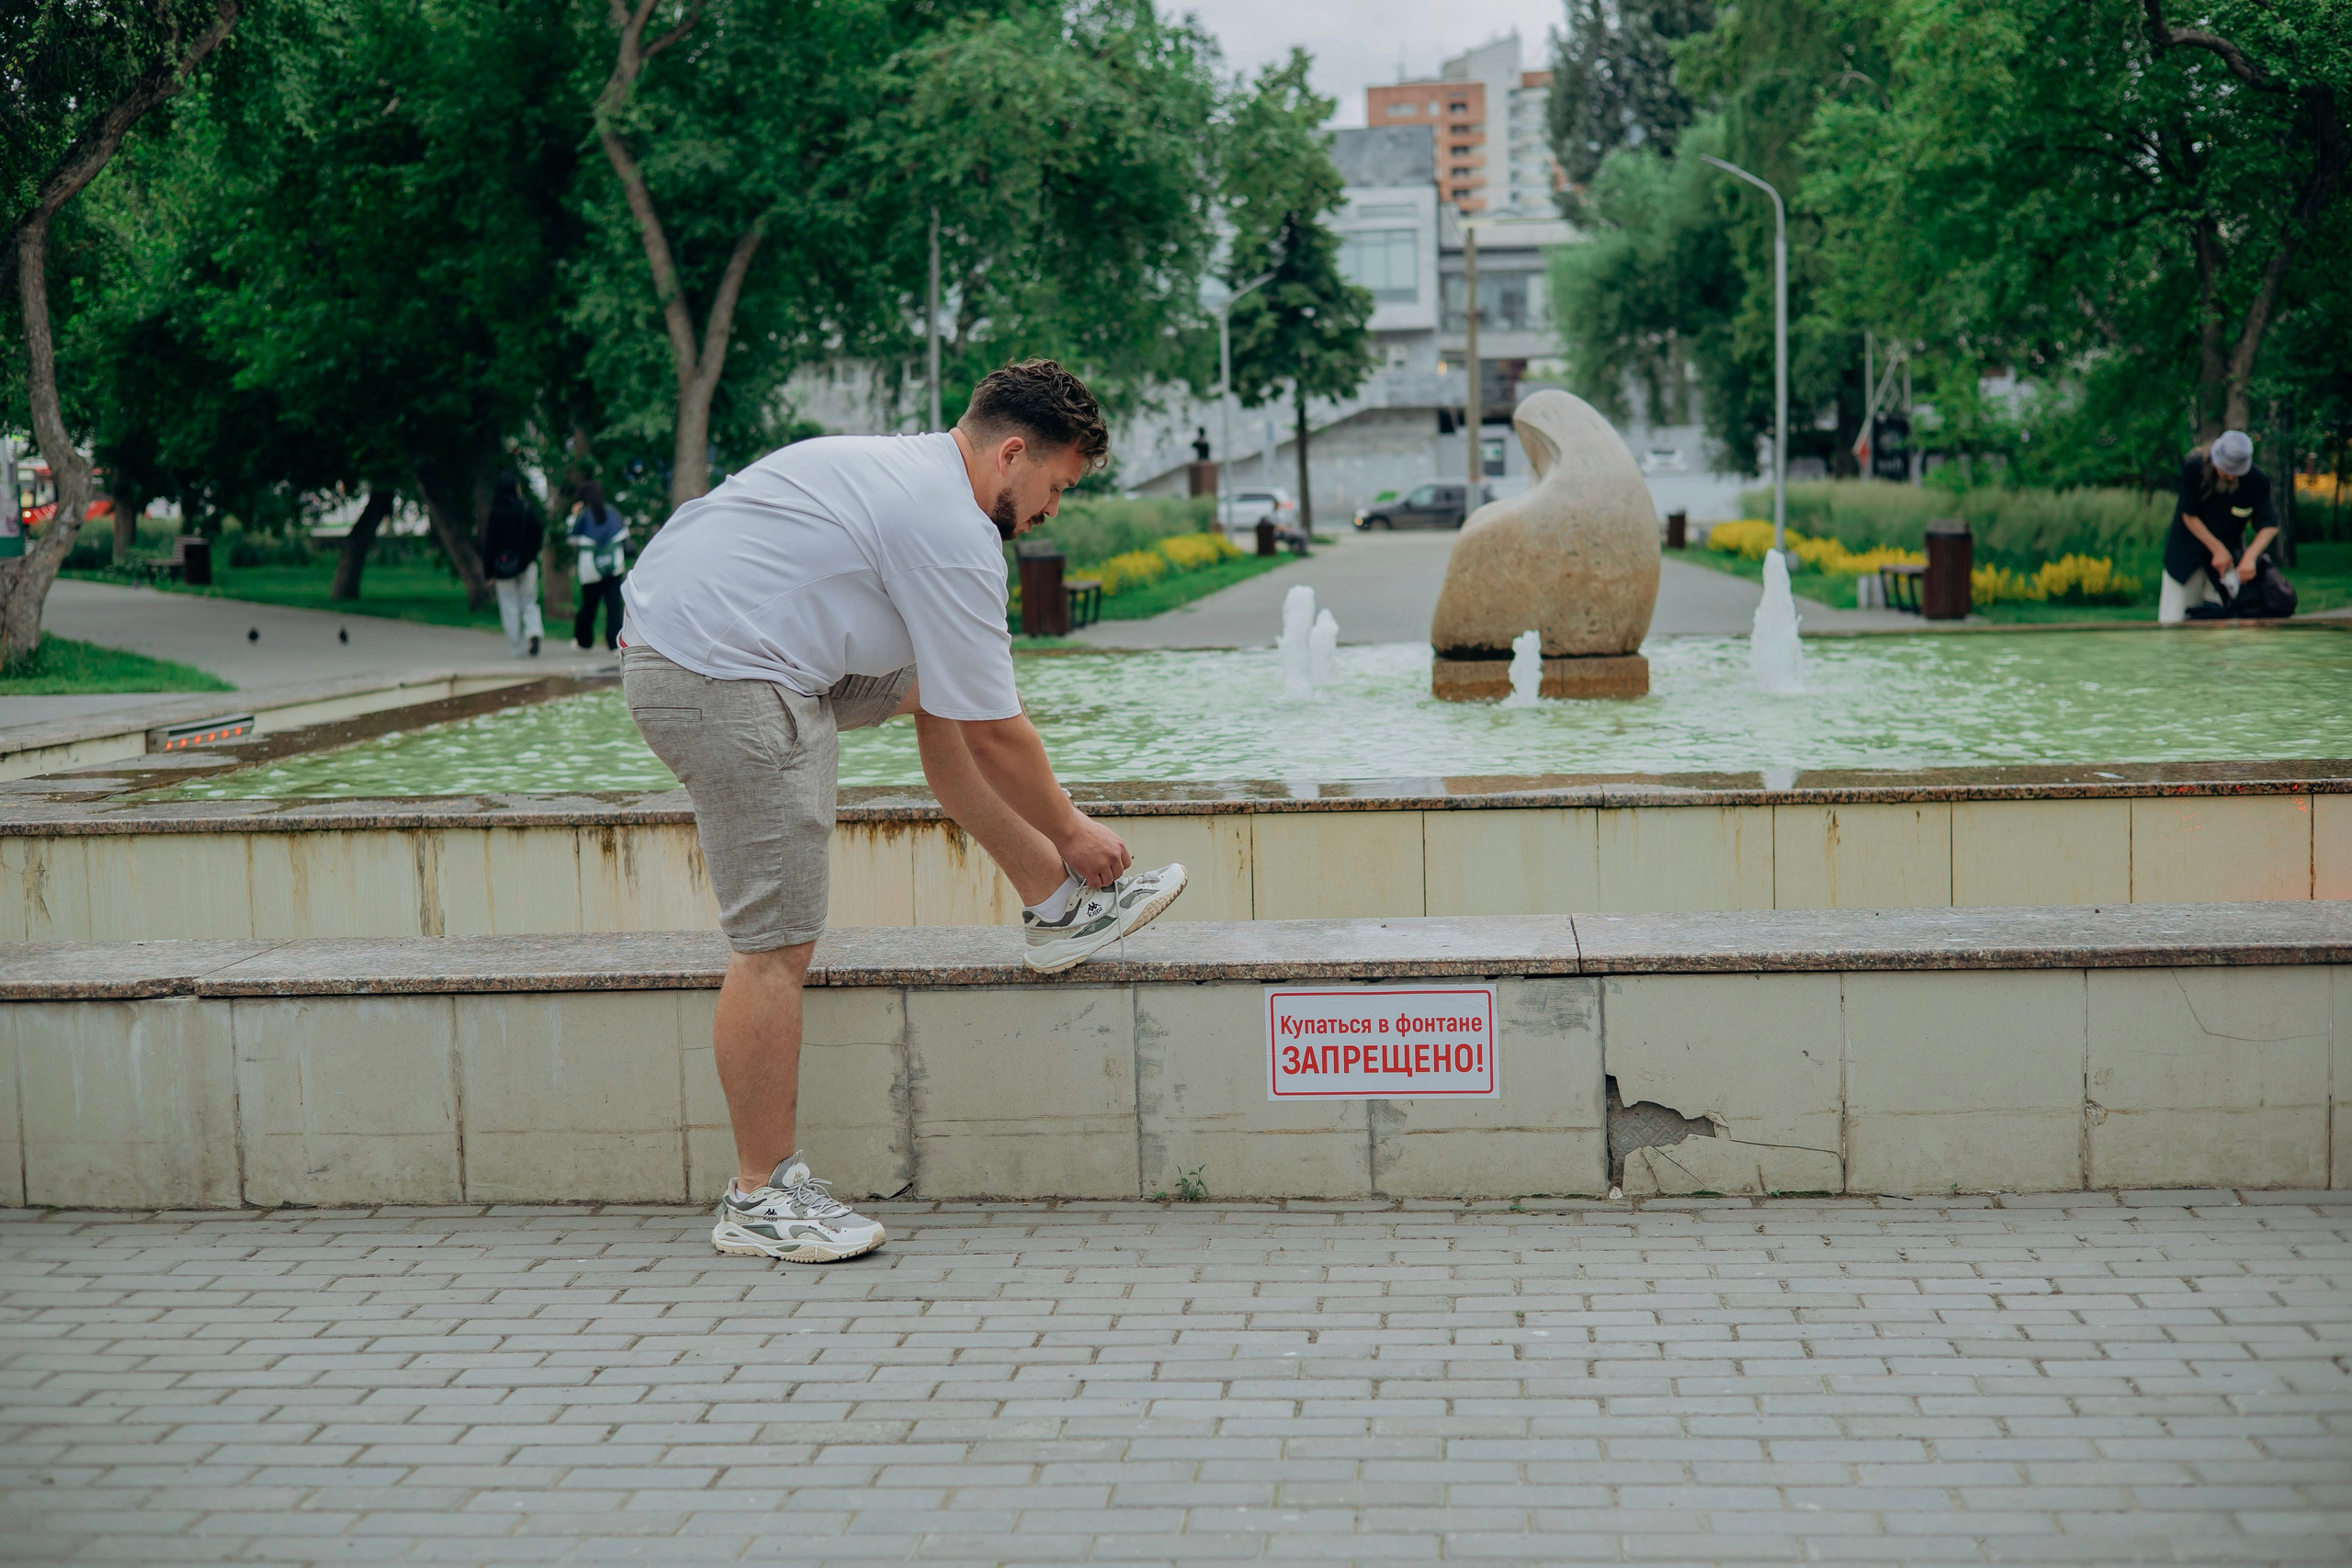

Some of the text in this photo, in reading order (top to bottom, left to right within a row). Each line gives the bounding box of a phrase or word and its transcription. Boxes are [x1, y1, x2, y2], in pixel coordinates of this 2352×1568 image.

[1280, 1012, 1483, 1039] Купаться в фонтане
[1282, 1043, 1484, 1077] ЗАПРЕЩЕНО!
